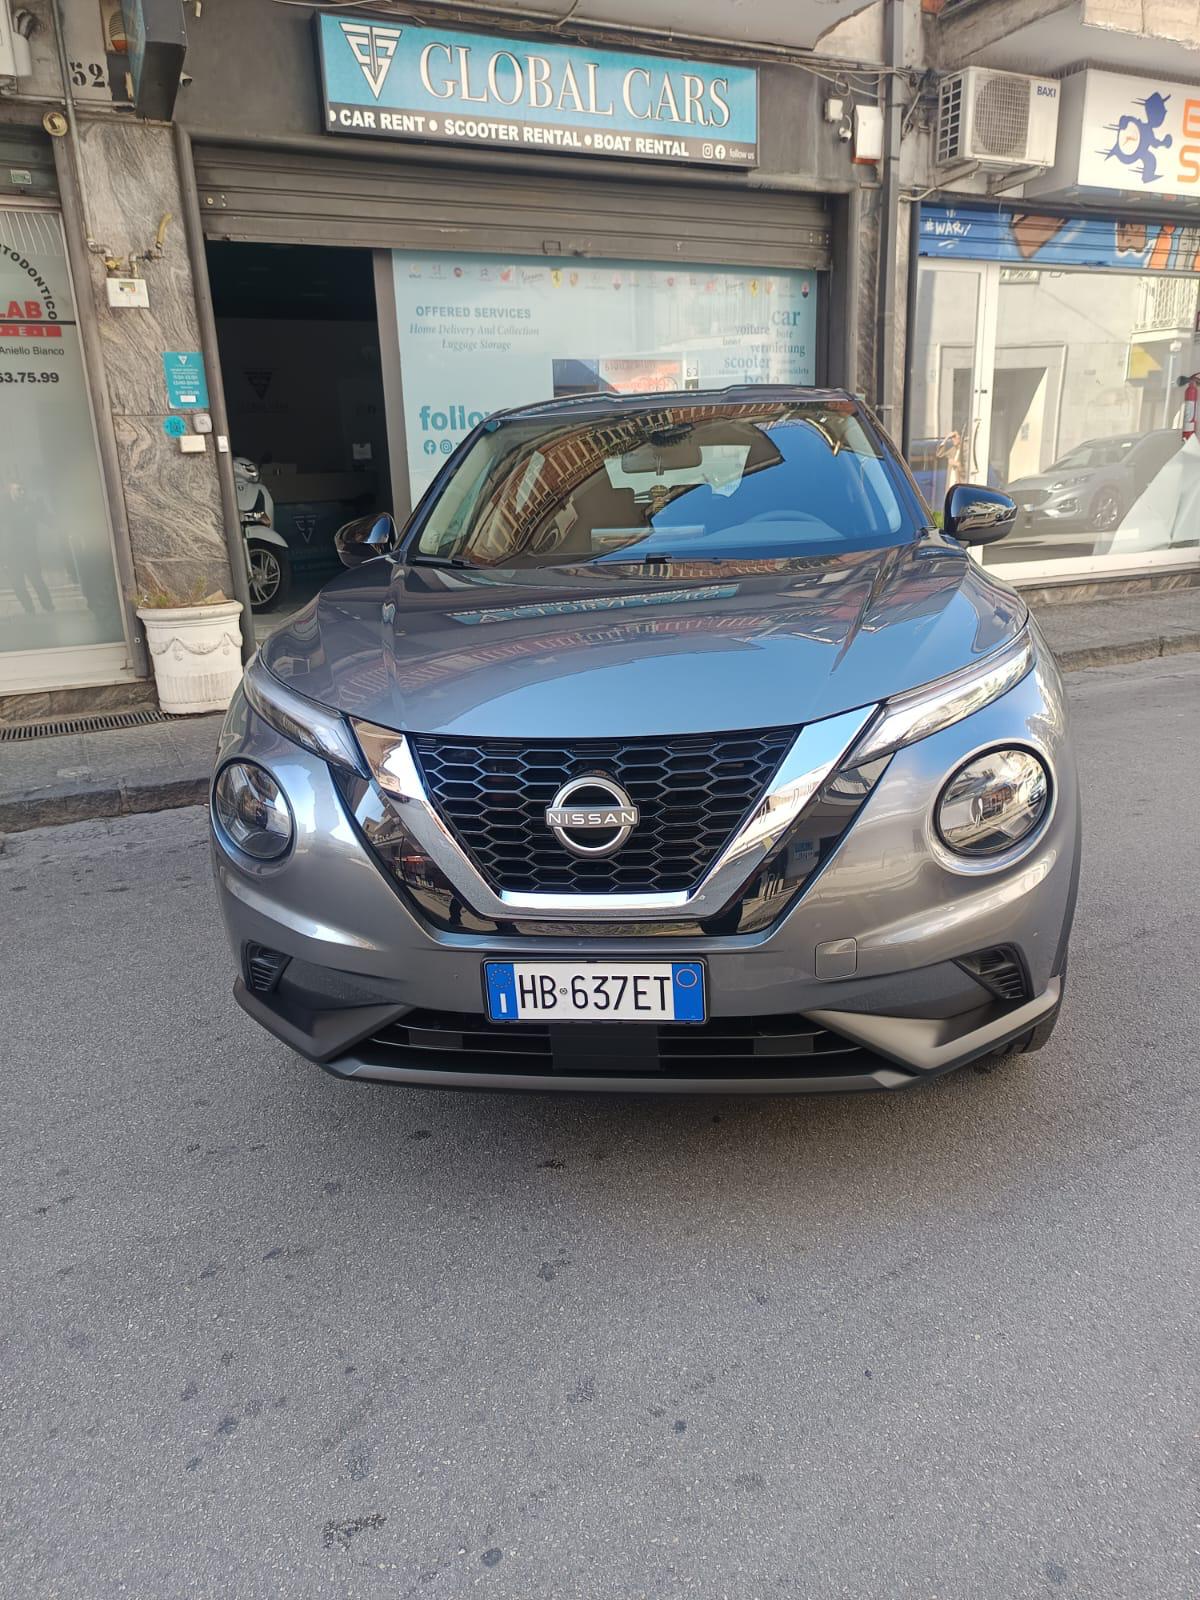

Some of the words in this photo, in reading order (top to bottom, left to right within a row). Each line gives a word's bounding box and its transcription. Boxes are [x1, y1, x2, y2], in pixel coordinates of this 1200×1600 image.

[70, 61, 106, 89] 52
[418, 41, 614, 117] GLOBAL
[621, 66, 731, 129] CARS
[1036, 85, 1057, 98] BAXI
[339, 109, 377, 129] CAR
[379, 112, 426, 133] RENT
[444, 119, 520, 141] SCOOTER
[523, 125, 582, 147] RENTAL
[593, 132, 632, 151] BOAT
[635, 137, 690, 157] RENTAL
[0, 243, 58, 320] TODONTICO
[416, 306, 471, 317] OFFERED
[473, 306, 532, 319] SERVICES
[772, 309, 801, 327] car
[408, 323, 437, 335] Home
[32, 346, 65, 356] Bianco
[723, 355, 771, 369] scooter
[548, 811, 635, 825] NISSAN
[518, 974, 558, 1010] HB
[570, 974, 671, 1011] 637ET
